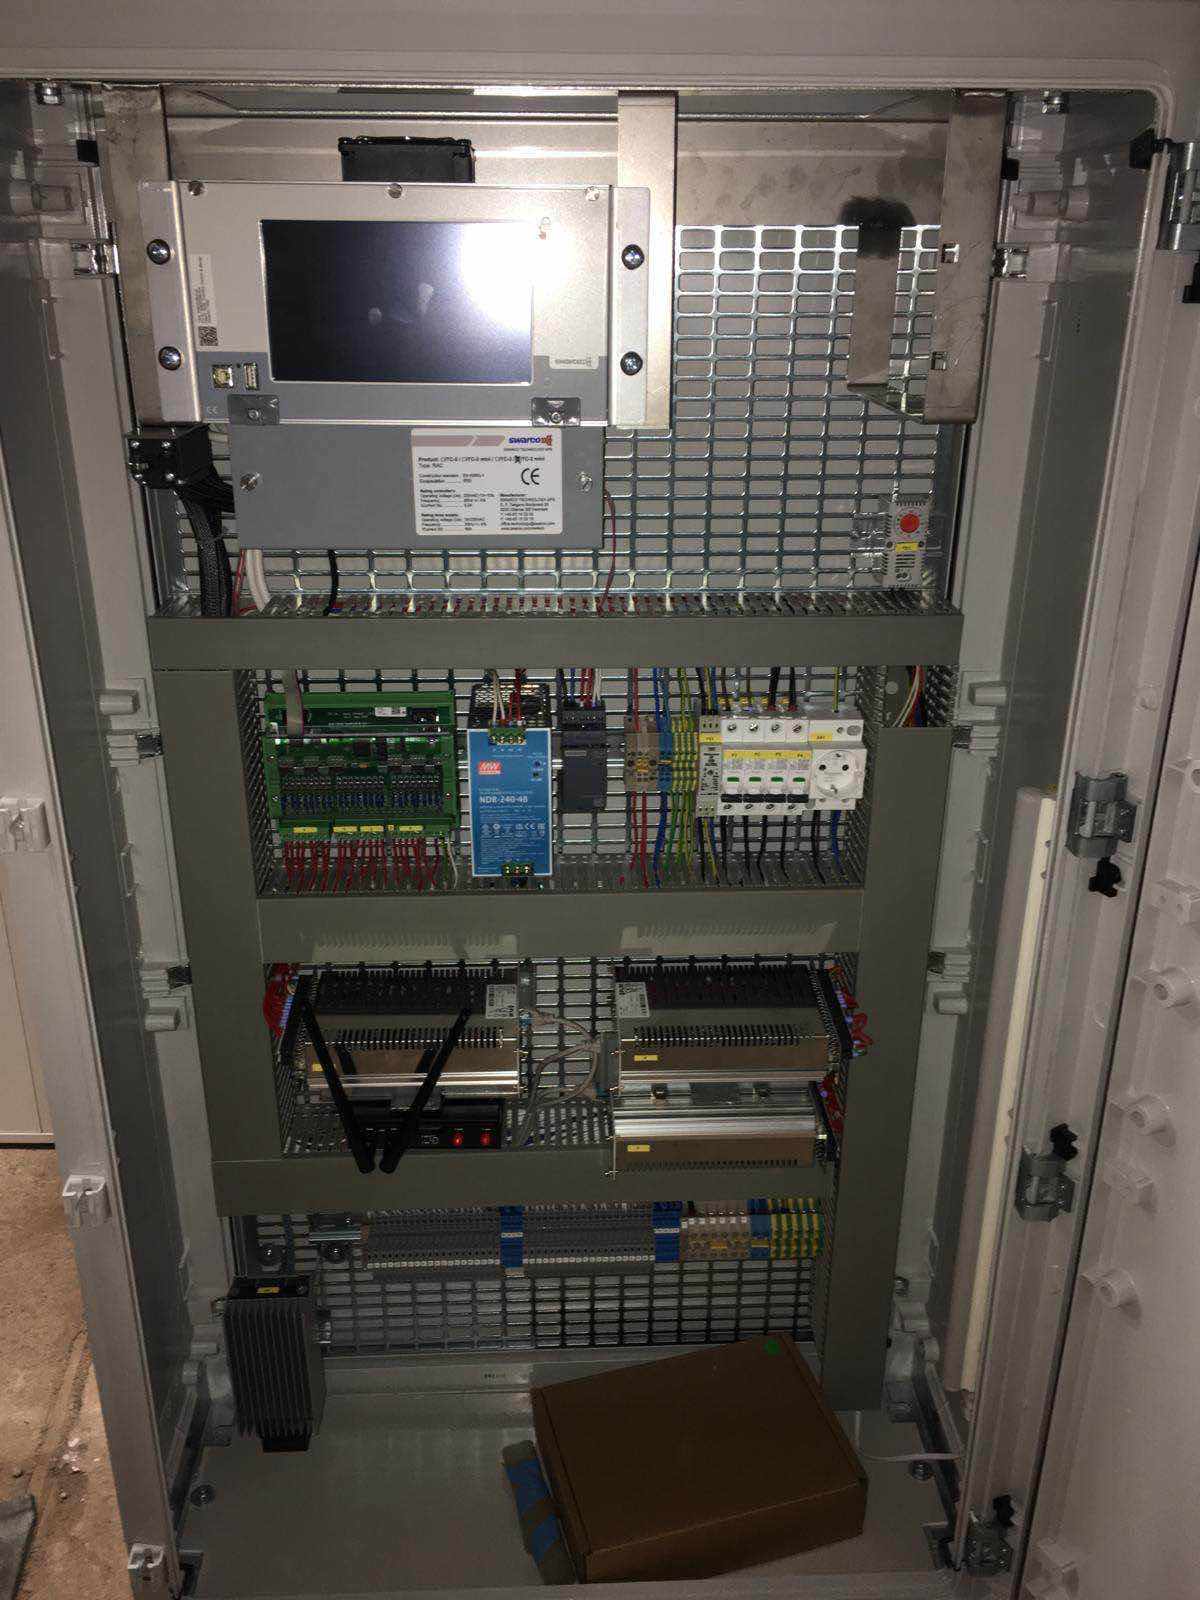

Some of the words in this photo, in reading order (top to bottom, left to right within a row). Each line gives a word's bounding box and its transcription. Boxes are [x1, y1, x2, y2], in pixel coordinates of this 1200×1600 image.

[508, 436, 541, 444] swarco
[520, 468, 540, 485] CE
[479, 795, 529, 803] NDR-240-48
